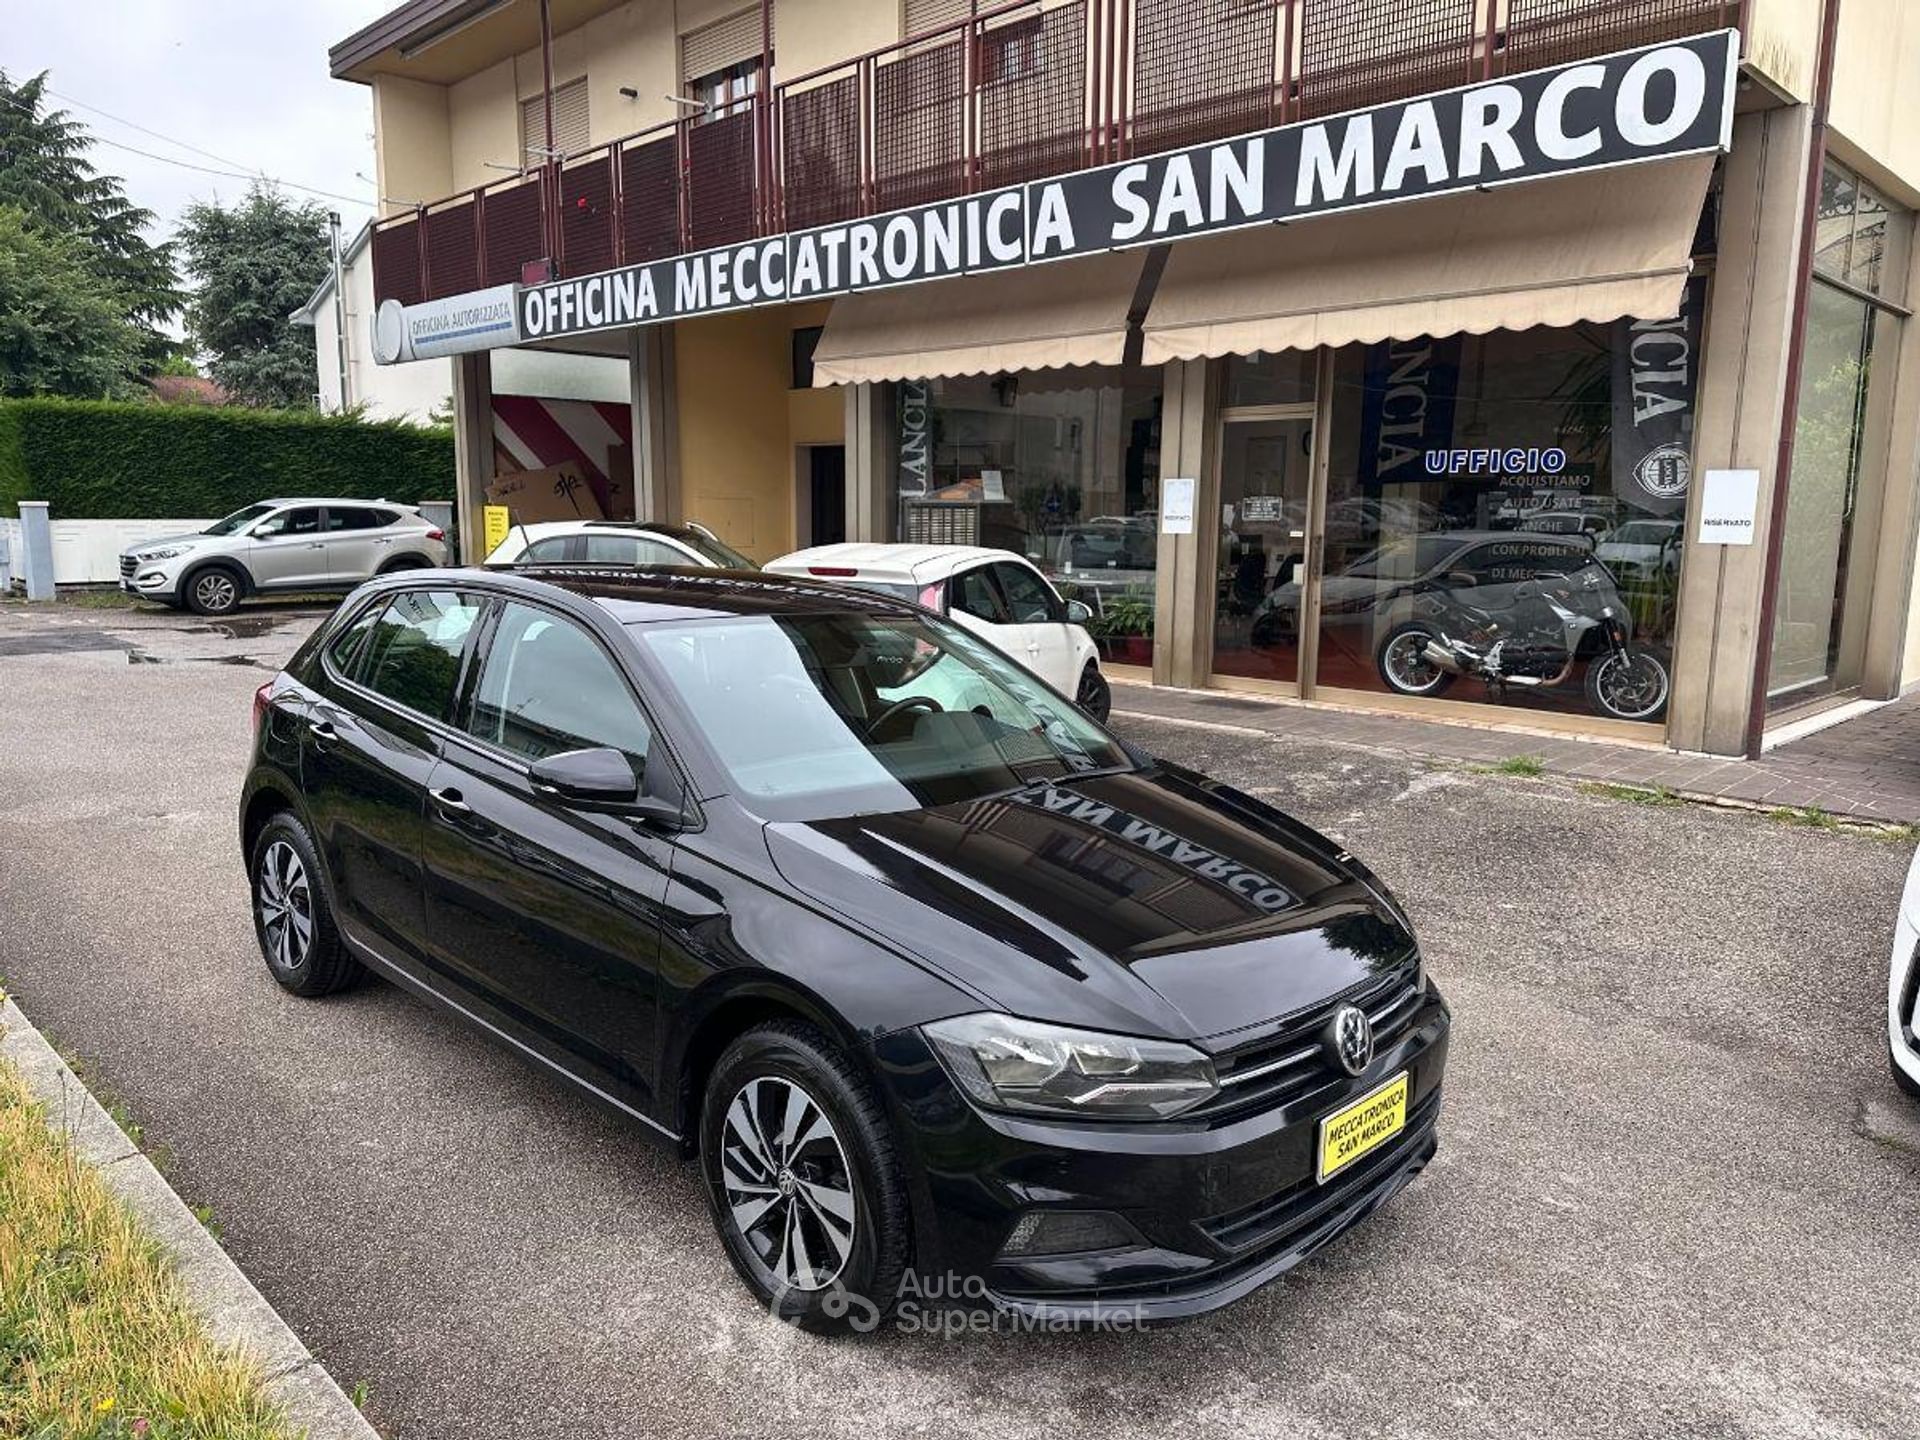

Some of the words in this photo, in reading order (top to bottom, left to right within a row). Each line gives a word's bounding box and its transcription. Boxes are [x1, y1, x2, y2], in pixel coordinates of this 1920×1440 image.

[525, 268, 658, 335] OFFICINA
[675, 182, 1076, 312] MECCATRONICA
[1111, 137, 1264, 240] SAN
[1295, 46, 1706, 207] MARCO
[412, 315, 450, 336] OFFICINA
[452, 302, 512, 328] AUTORIZZATA
[1425, 447, 1566, 474] UFFICIO
[1499, 475, 1590, 487] ACQUISTIAMO
[1503, 497, 1539, 508] AUTO
[1542, 497, 1582, 509] USATE
[1521, 521, 1563, 532] ANCHE
[1492, 544, 1518, 555] CON
[1521, 545, 1586, 557] PROBLEI
[1491, 568, 1504, 578] DI
[1328, 1089, 1405, 1146] MECCATRONICA
[1337, 1134, 1358, 1158] SAN
[1360, 1112, 1395, 1145] MARCO
